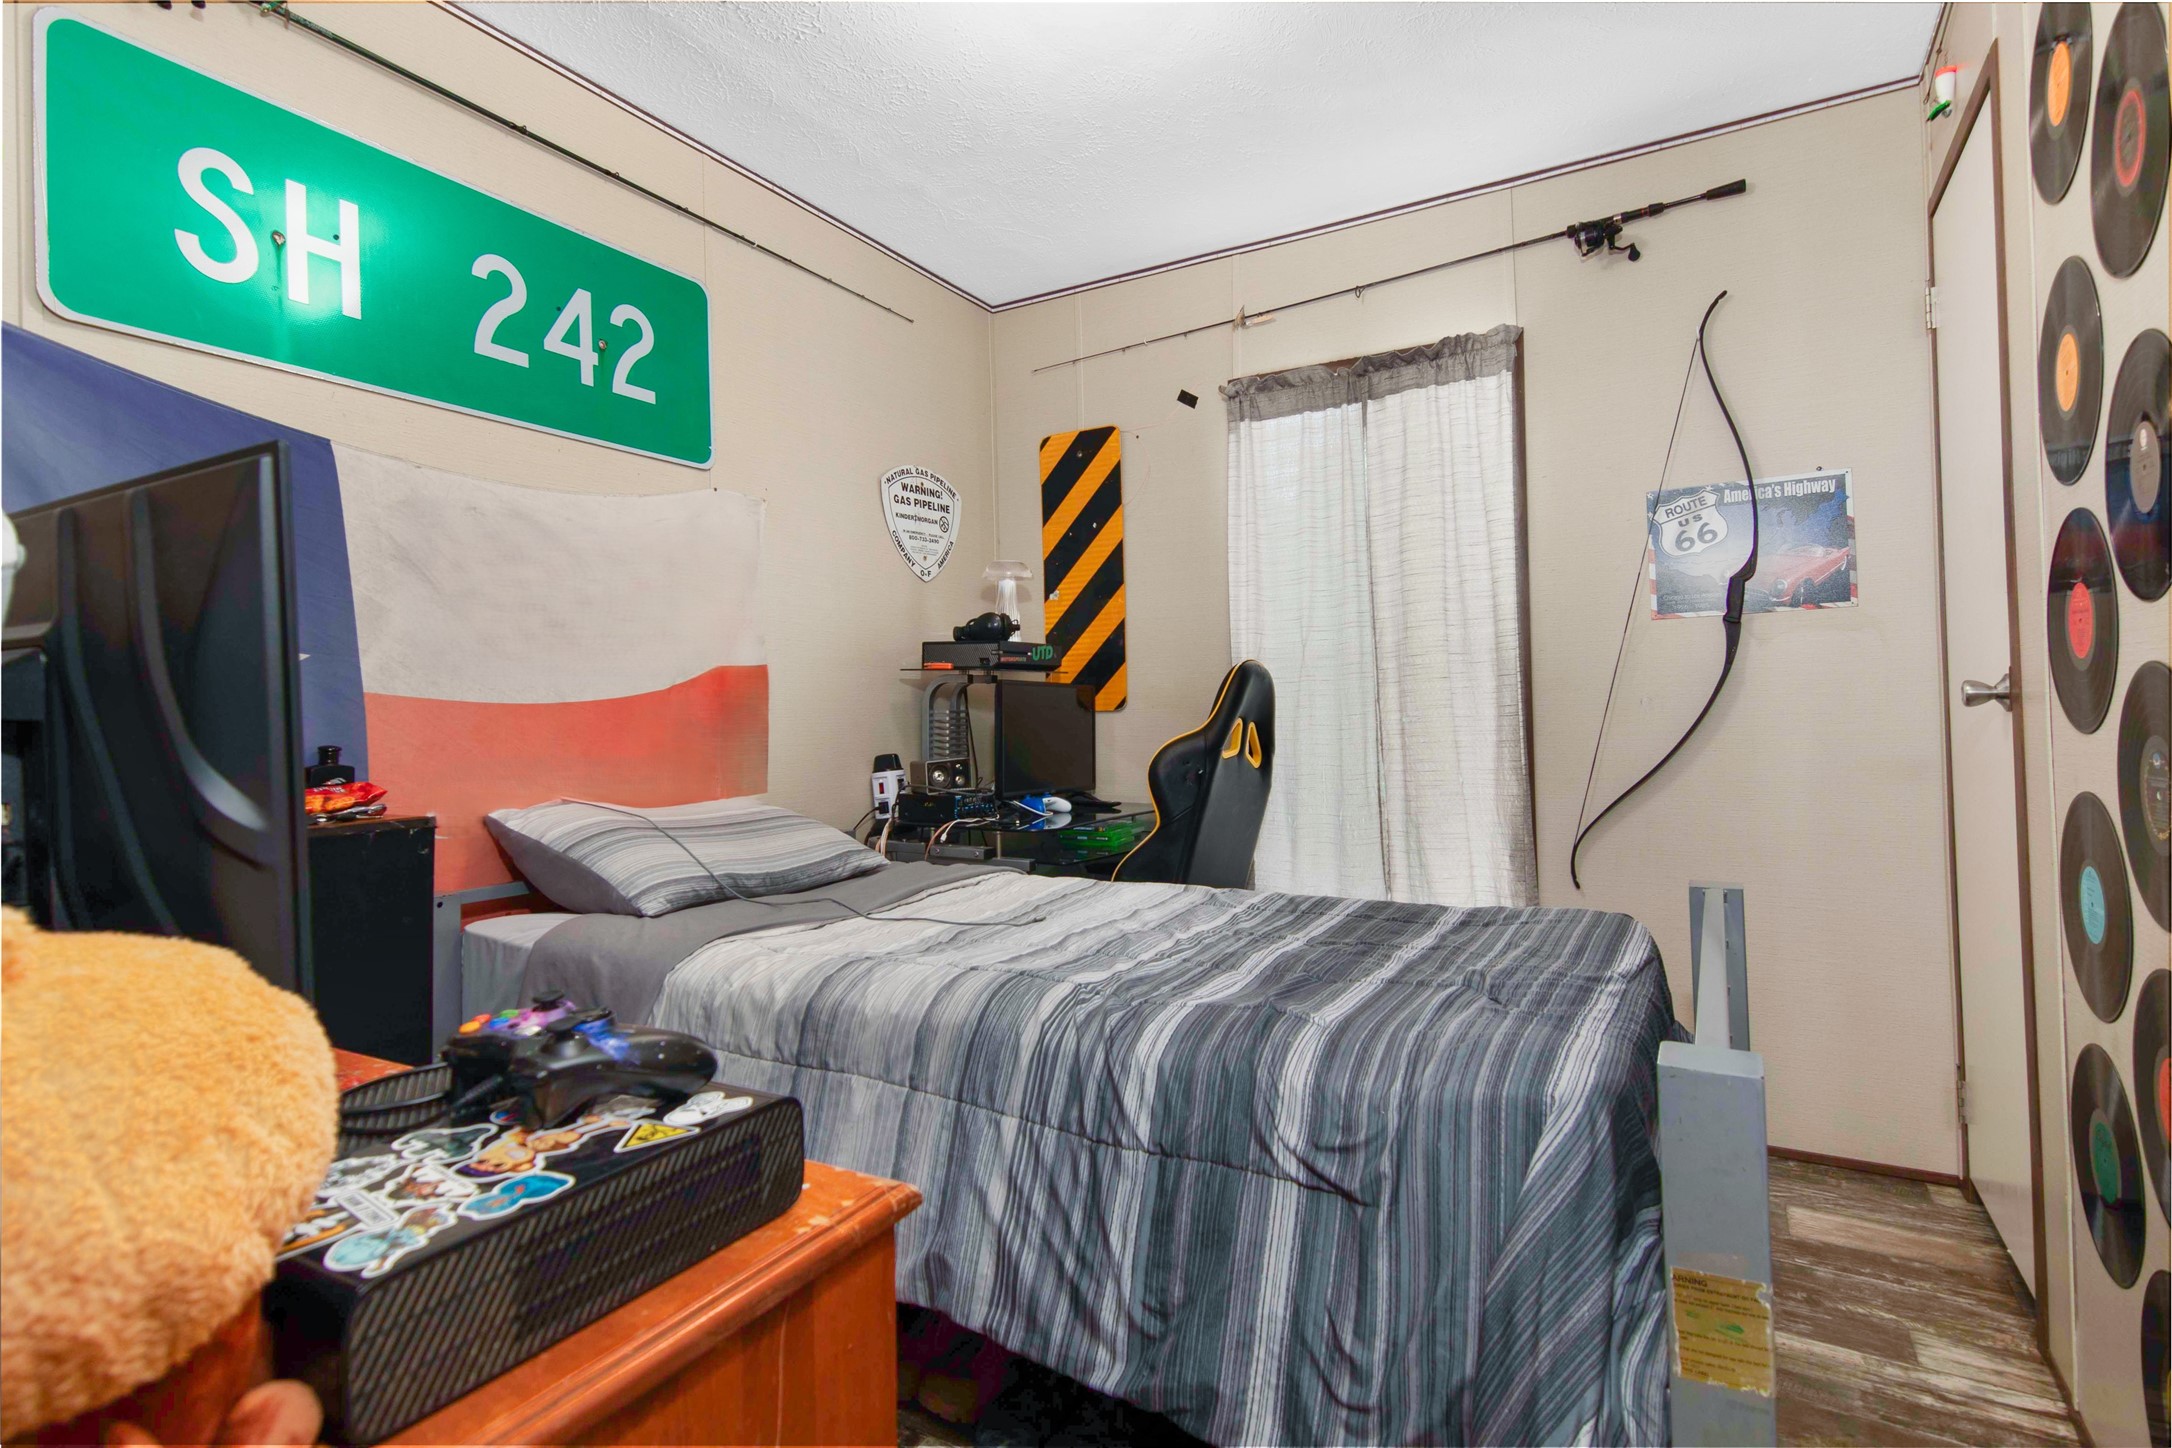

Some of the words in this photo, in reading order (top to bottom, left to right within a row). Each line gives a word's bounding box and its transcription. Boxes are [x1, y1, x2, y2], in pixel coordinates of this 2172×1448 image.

[174, 147, 361, 320] SH
[471, 253, 656, 405] 242
[886, 467, 914, 485] NATURAL
[915, 467, 929, 478] GAS
[930, 473, 957, 499] PIPELINE
[901, 481, 943, 500] WARNING!
[1723, 484, 1781, 503] Ameica's
[1783, 479, 1836, 497] Highway
[893, 494, 911, 506] GAS
[914, 498, 951, 514] PIPELINE
[1664, 495, 1708, 519] ROUTE
[1675, 522, 1718, 552] 66
[891, 530, 916, 567] COMPANY
[937, 541, 954, 569] AMERICA
[1032, 645, 1054, 661] UTD
